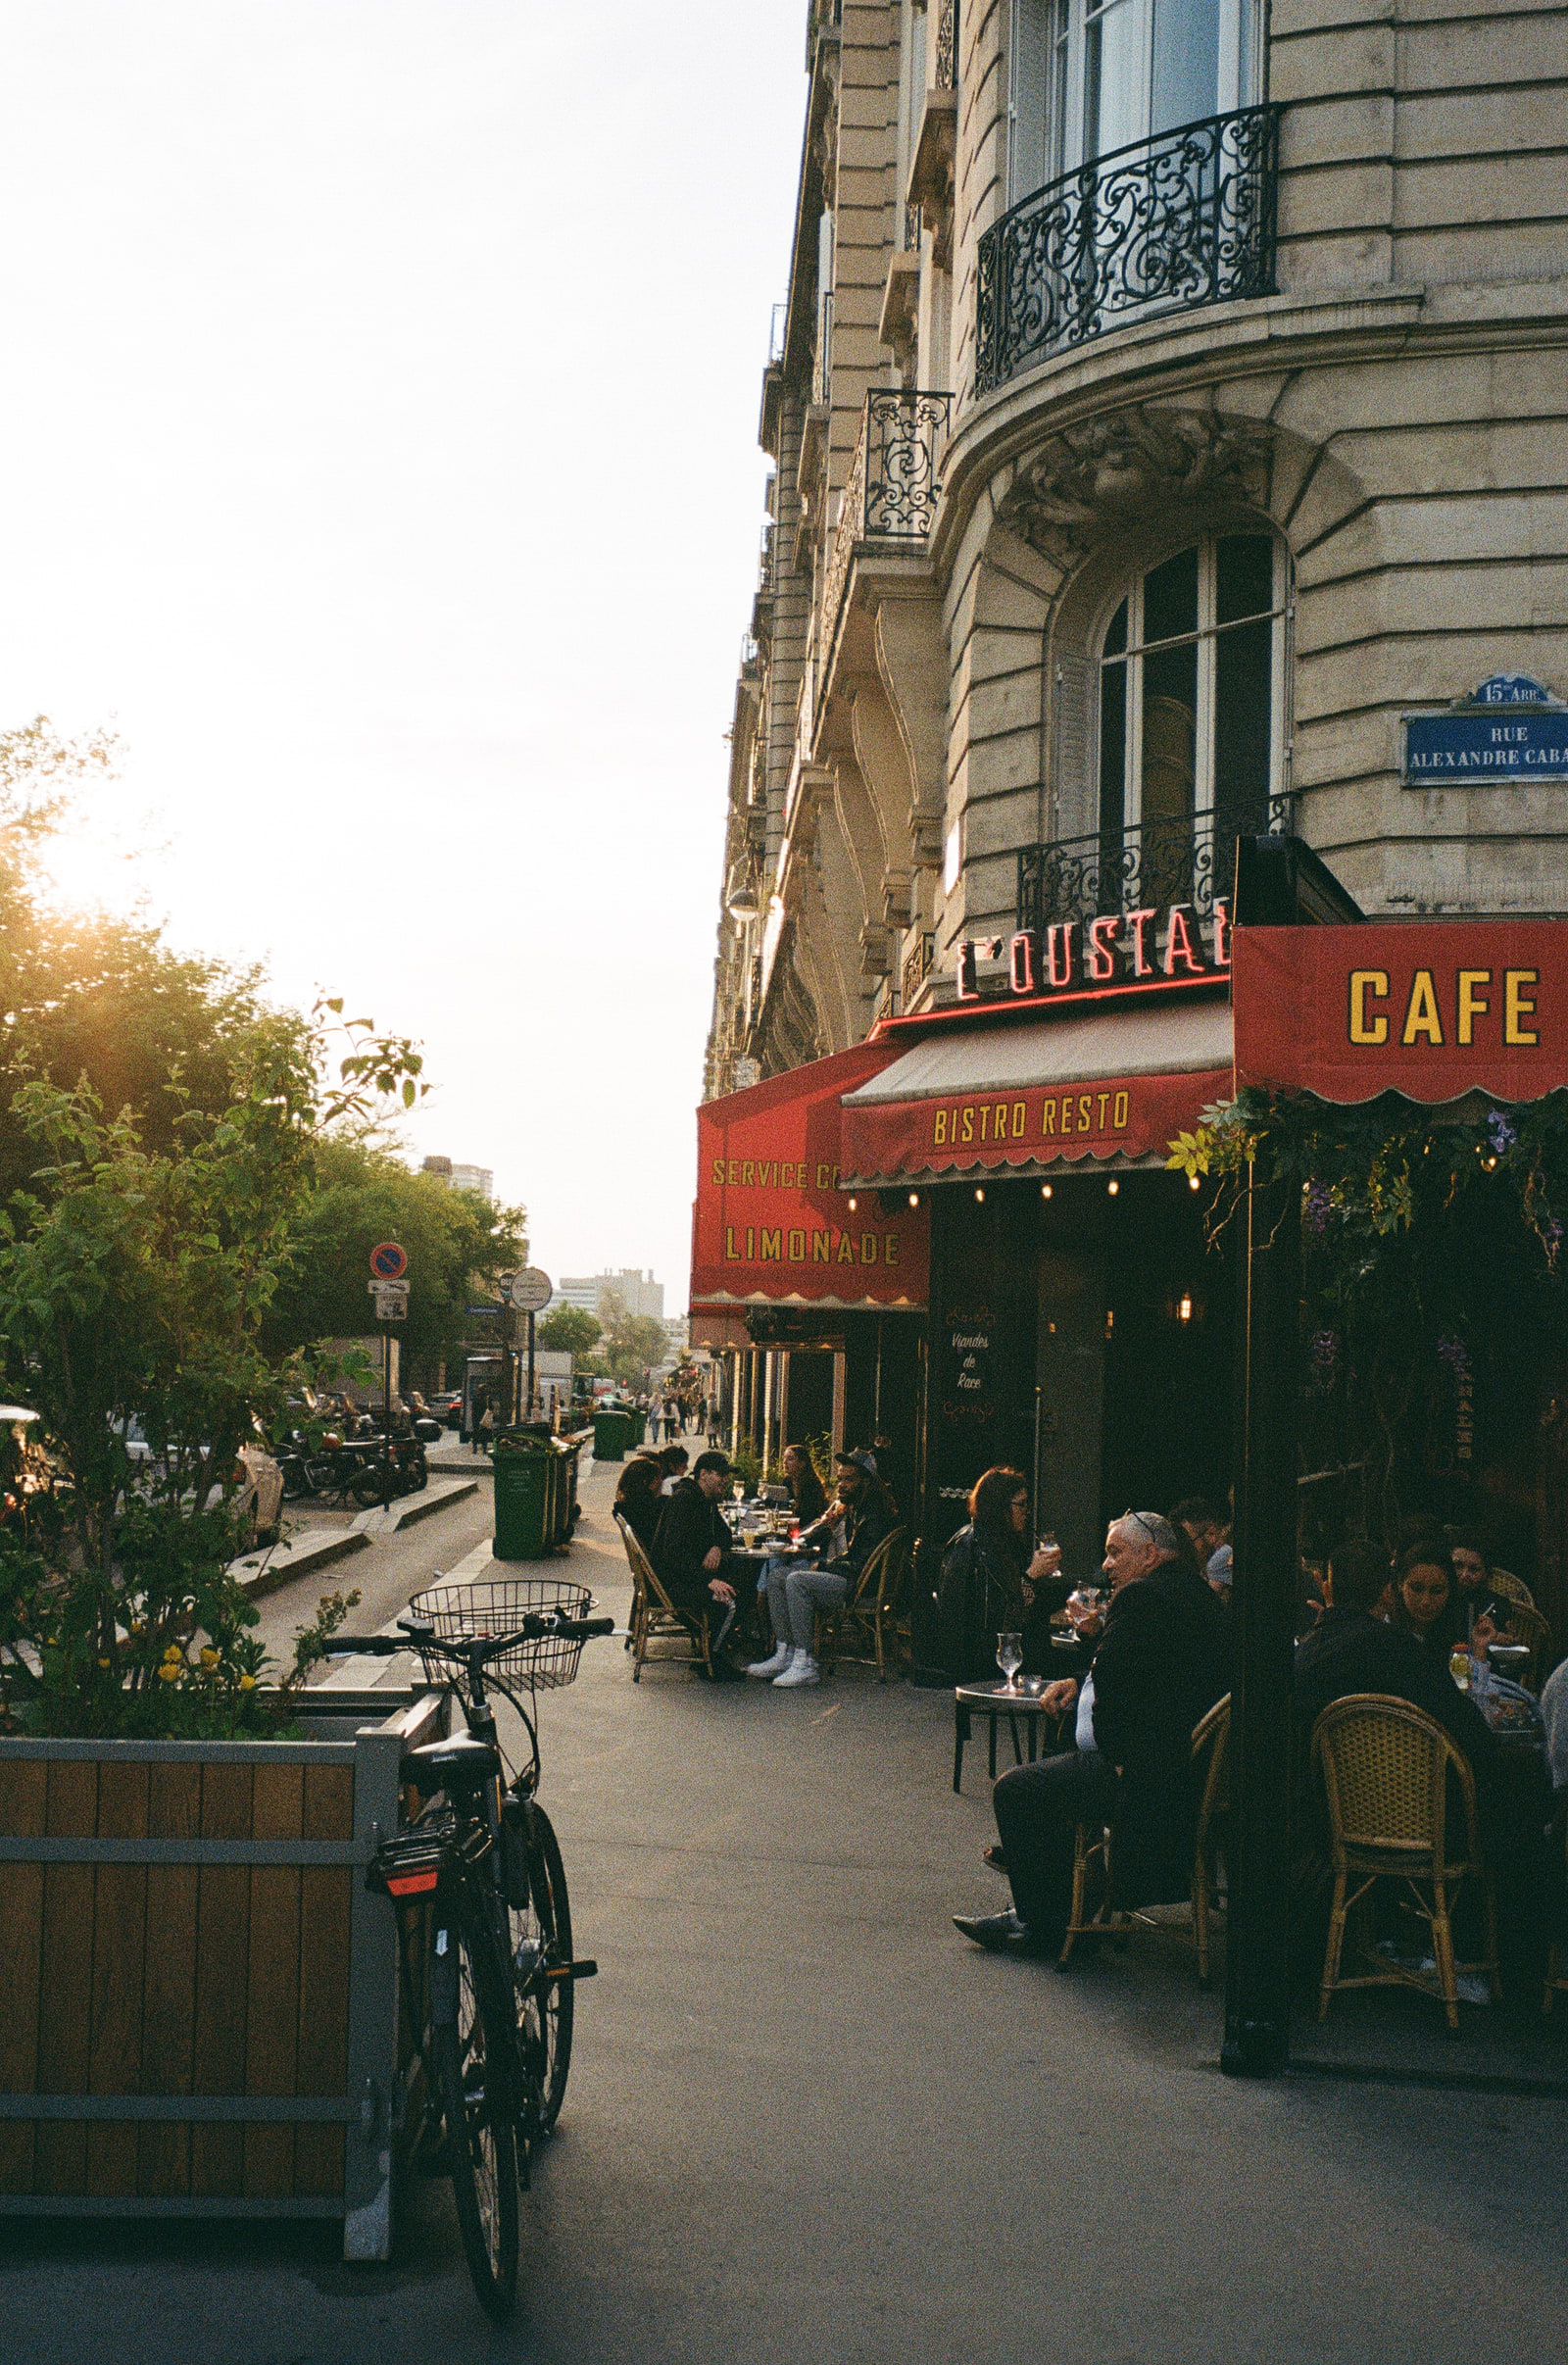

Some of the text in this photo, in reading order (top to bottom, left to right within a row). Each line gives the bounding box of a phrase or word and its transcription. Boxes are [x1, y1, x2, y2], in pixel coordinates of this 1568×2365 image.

[1491, 727, 1529, 742] RUE
[1410, 750, 1520, 767] ALEXANDRE
[1348, 967, 1541, 1047] CAFE
[933, 1090, 1129, 1146] BISTRO RESTO
[711, 1158, 808, 1190] SERVICE
[725, 1226, 901, 1266] LIMONADE
[952, 1332, 989, 1348] Viandes
[963, 1354, 976, 1368] de
[956, 1372, 981, 1389] Race
